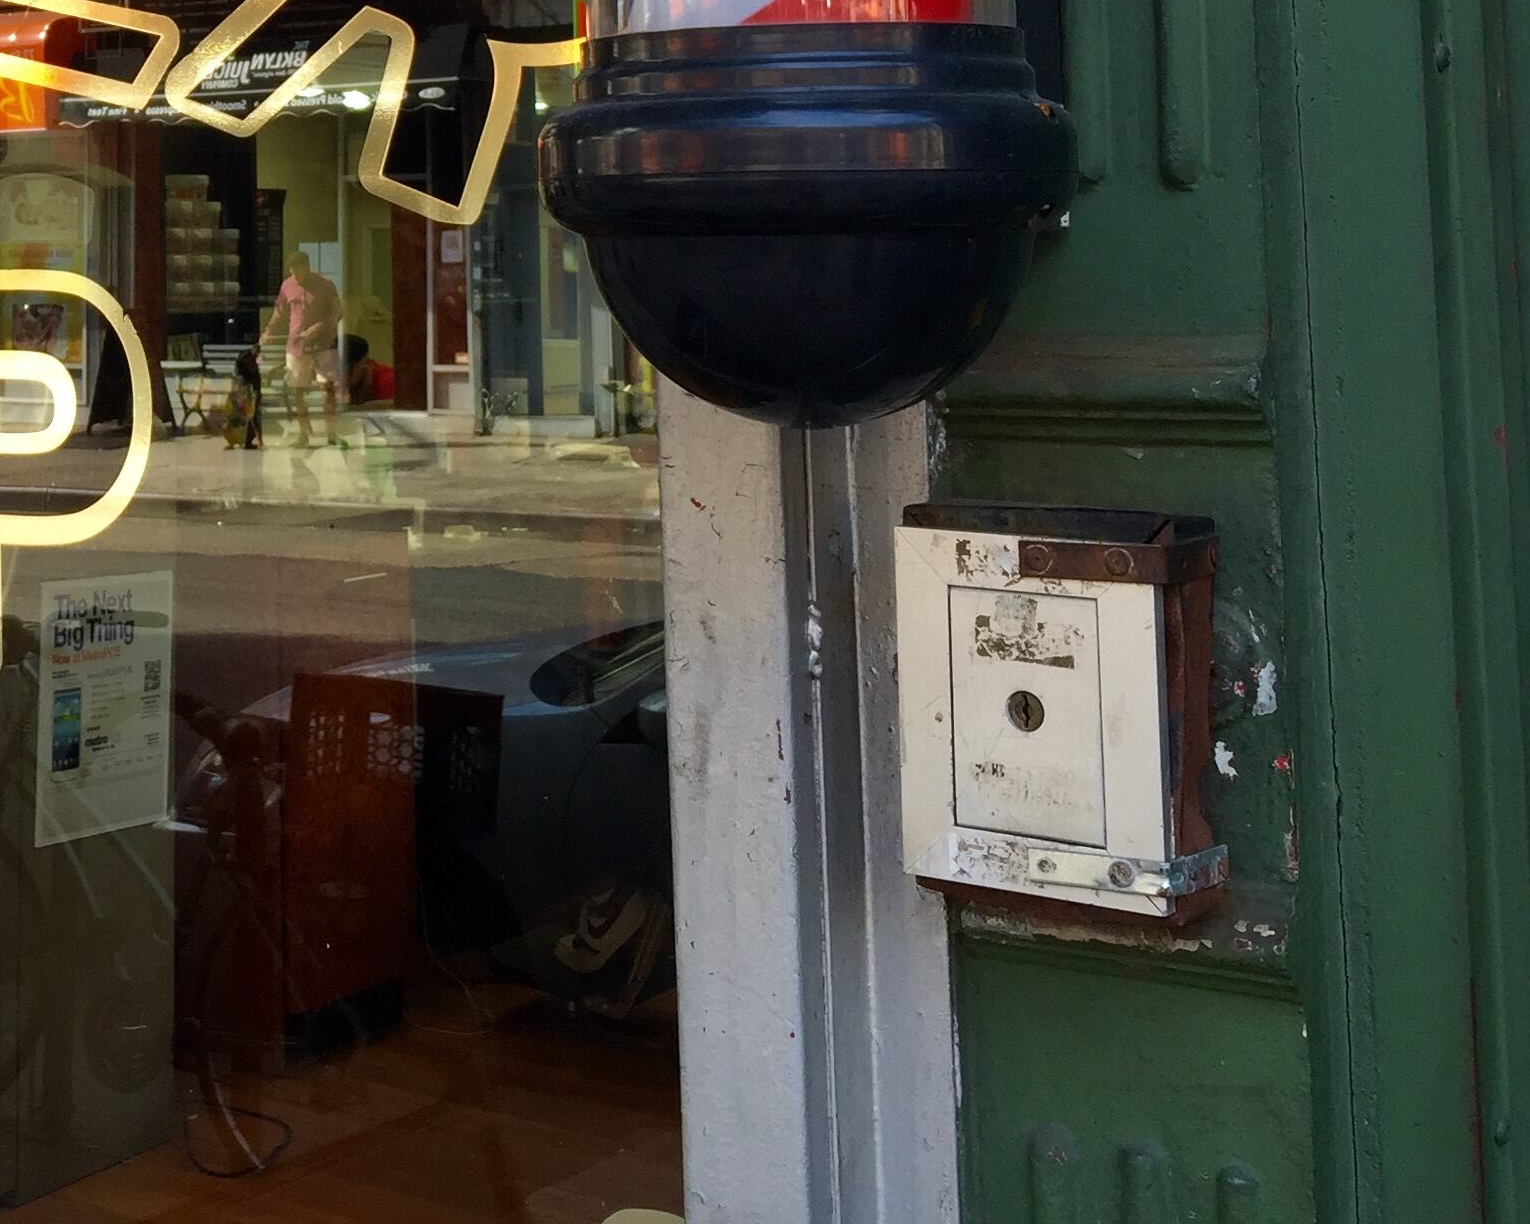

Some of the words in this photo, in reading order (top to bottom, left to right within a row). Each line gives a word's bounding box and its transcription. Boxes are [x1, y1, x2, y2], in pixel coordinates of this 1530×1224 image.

[53, 593, 88, 620] The
[93, 588, 134, 616] Next
[53, 619, 85, 652] Big
[86, 616, 135, 647] Thing
